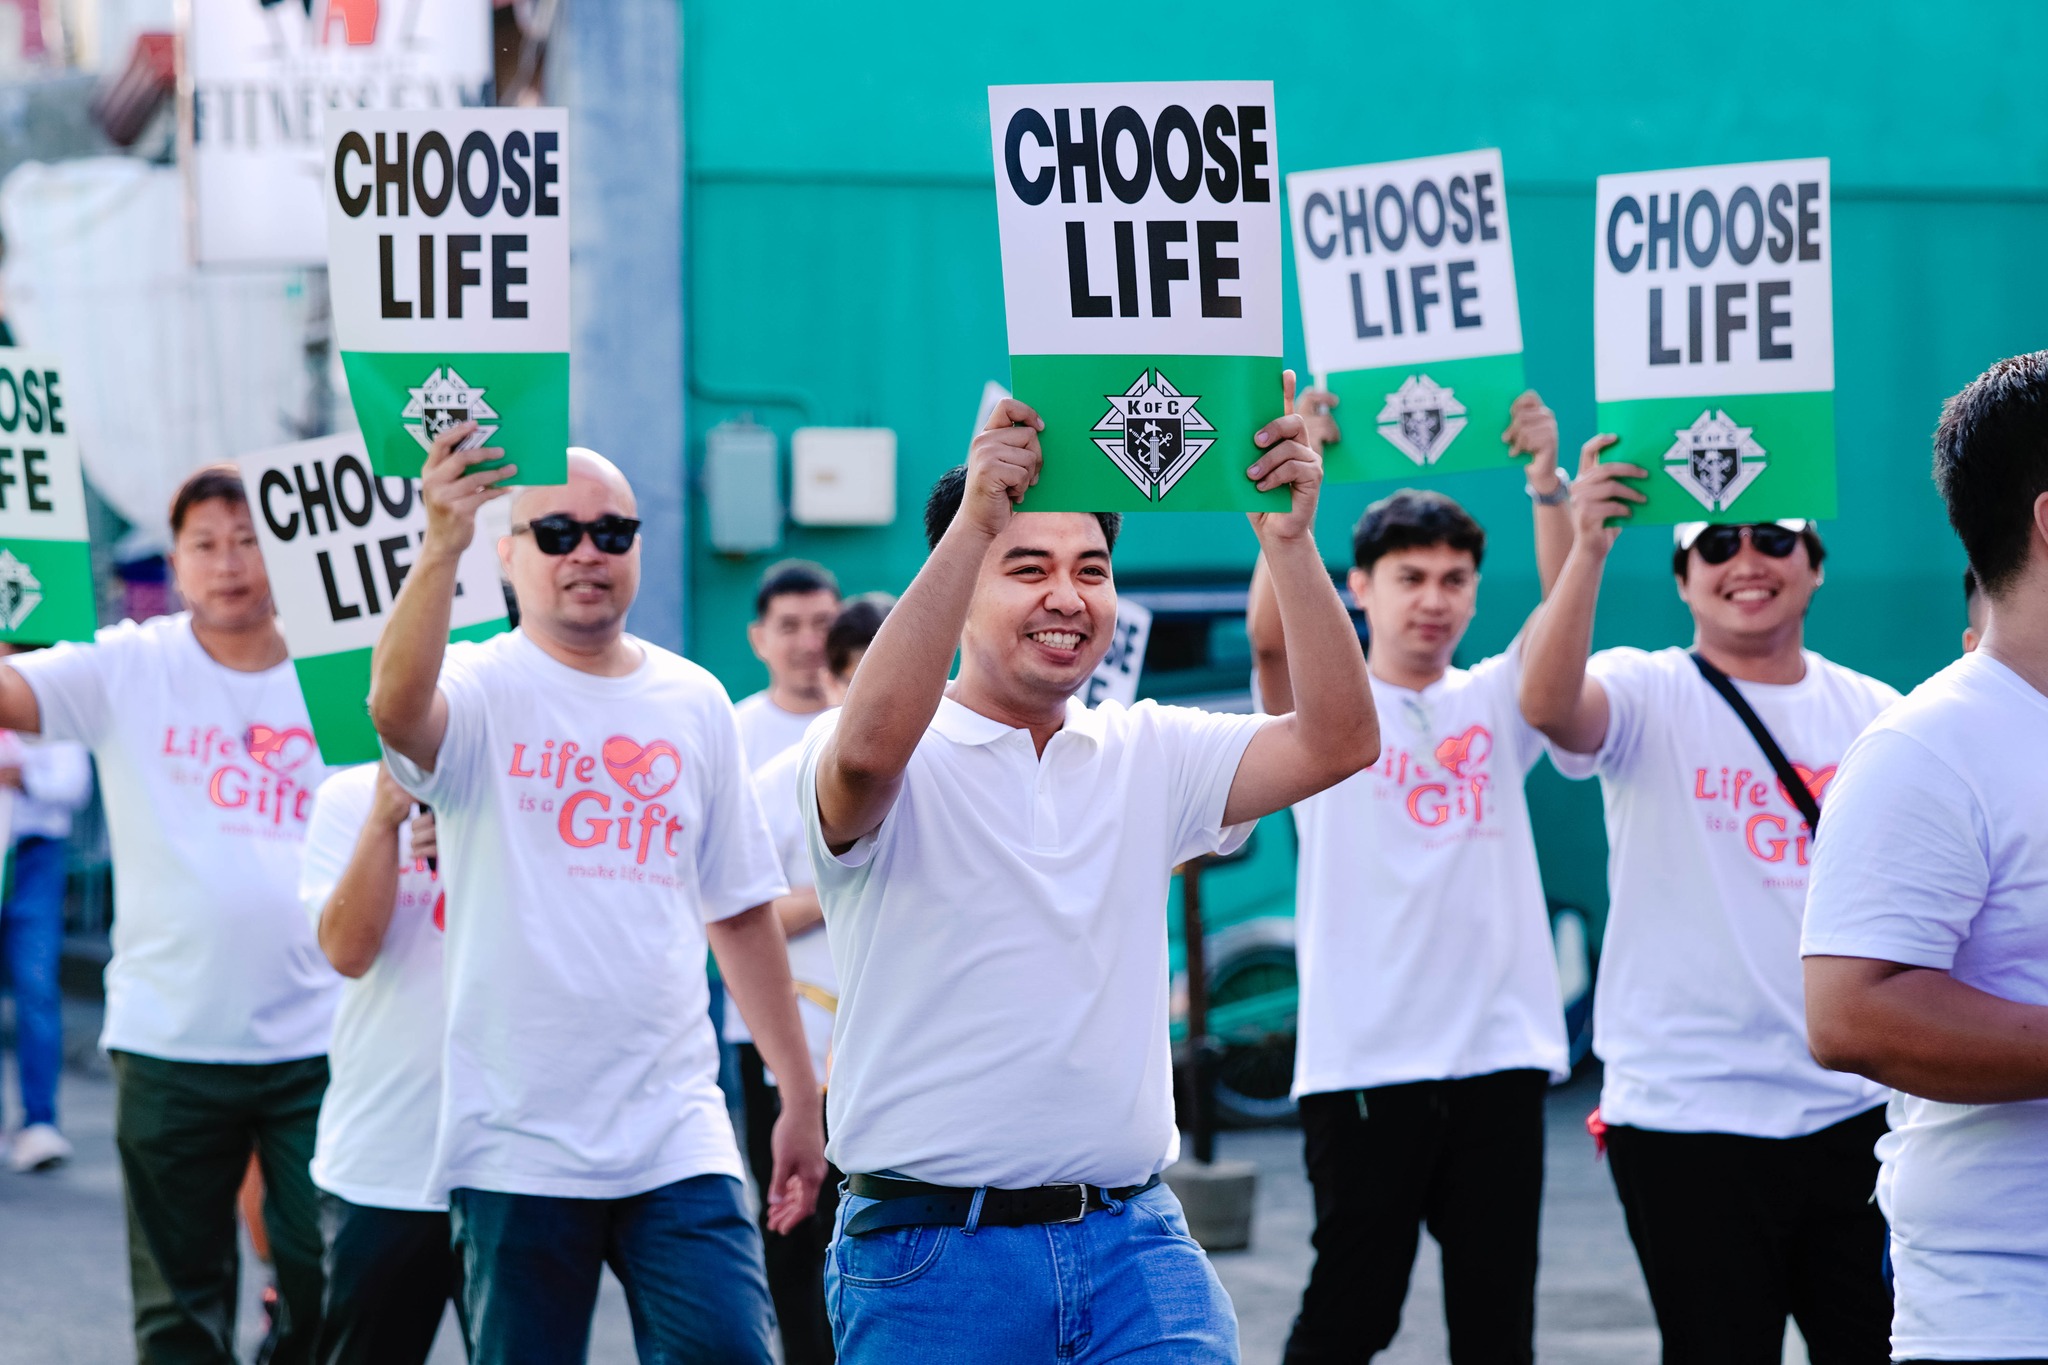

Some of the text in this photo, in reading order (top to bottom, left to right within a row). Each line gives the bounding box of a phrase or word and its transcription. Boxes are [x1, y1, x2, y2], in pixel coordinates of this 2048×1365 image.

[335, 131, 559, 217] CHOOSE
[1005, 104, 1270, 205] CHOOSE
[1304, 173, 1498, 259] CHOOSE
[1607, 183, 1821, 273] CHOOSE
[379, 234, 528, 318] LIFE
[1065, 221, 1242, 318] LIFE
[1349, 260, 1482, 339] LIFE
[1649, 281, 1793, 365] LIFE
[0, 368, 65, 433] OSE
[457, 393, 467, 404] C
[1128, 400, 1179, 415] K OF C
[260, 455, 426, 541] CHOO
[317, 533, 463, 621] LIF
[164, 726, 236, 765] Life
[508, 740, 595, 788] Life
[209, 766, 309, 824] Gift
[519, 793, 536, 812] is
[1406, 774, 1493, 826] Gif
[1695, 768, 1768, 811] Life
[558, 790, 683, 864] Gift
[1746, 814, 1808, 865] Gi
